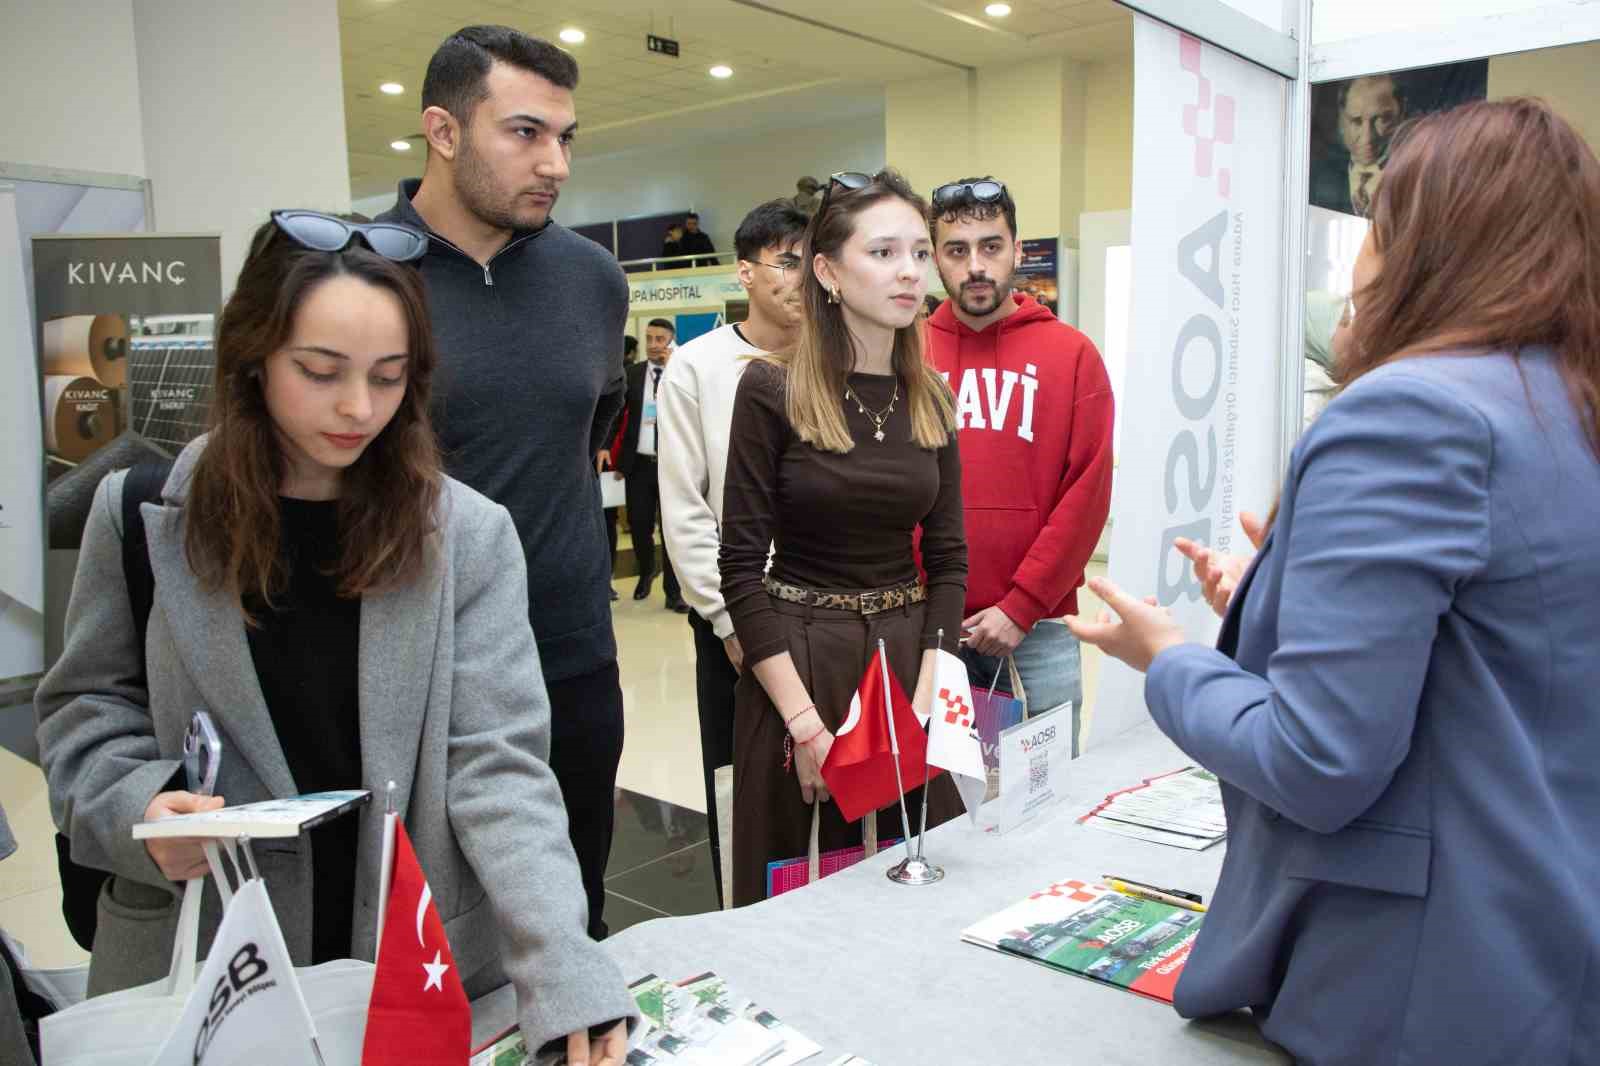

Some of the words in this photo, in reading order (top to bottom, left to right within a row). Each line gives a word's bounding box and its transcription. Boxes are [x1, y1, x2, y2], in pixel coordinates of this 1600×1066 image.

[68, 261, 186, 286] KIVANÇ
[937, 362, 1039, 443] AVİ
[1031, 726, 1056, 748] AOSB
